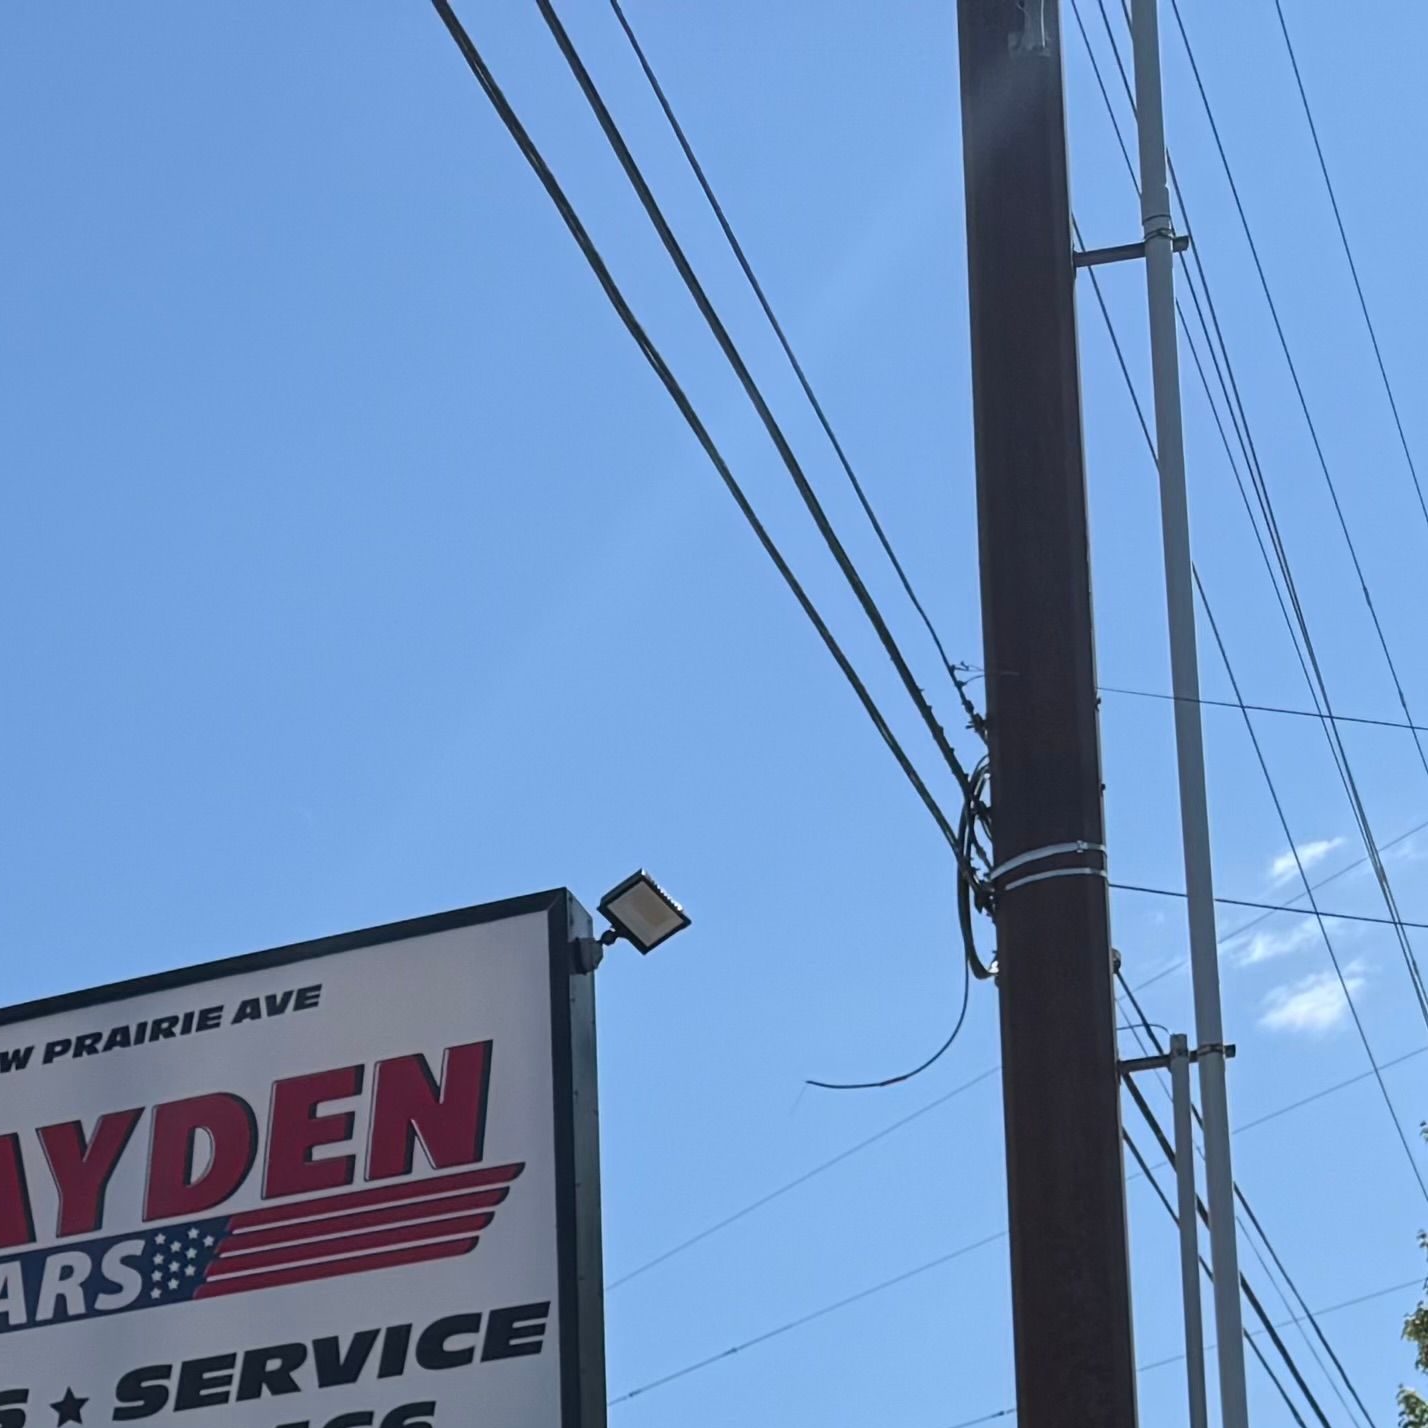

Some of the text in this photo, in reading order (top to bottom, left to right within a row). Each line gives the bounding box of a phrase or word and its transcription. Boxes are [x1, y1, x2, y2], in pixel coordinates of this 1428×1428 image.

[42, 1004, 225, 1065] PRAIRIE
[230, 983, 323, 1026] AVE
[111, 1300, 552, 1421] SERVICE
